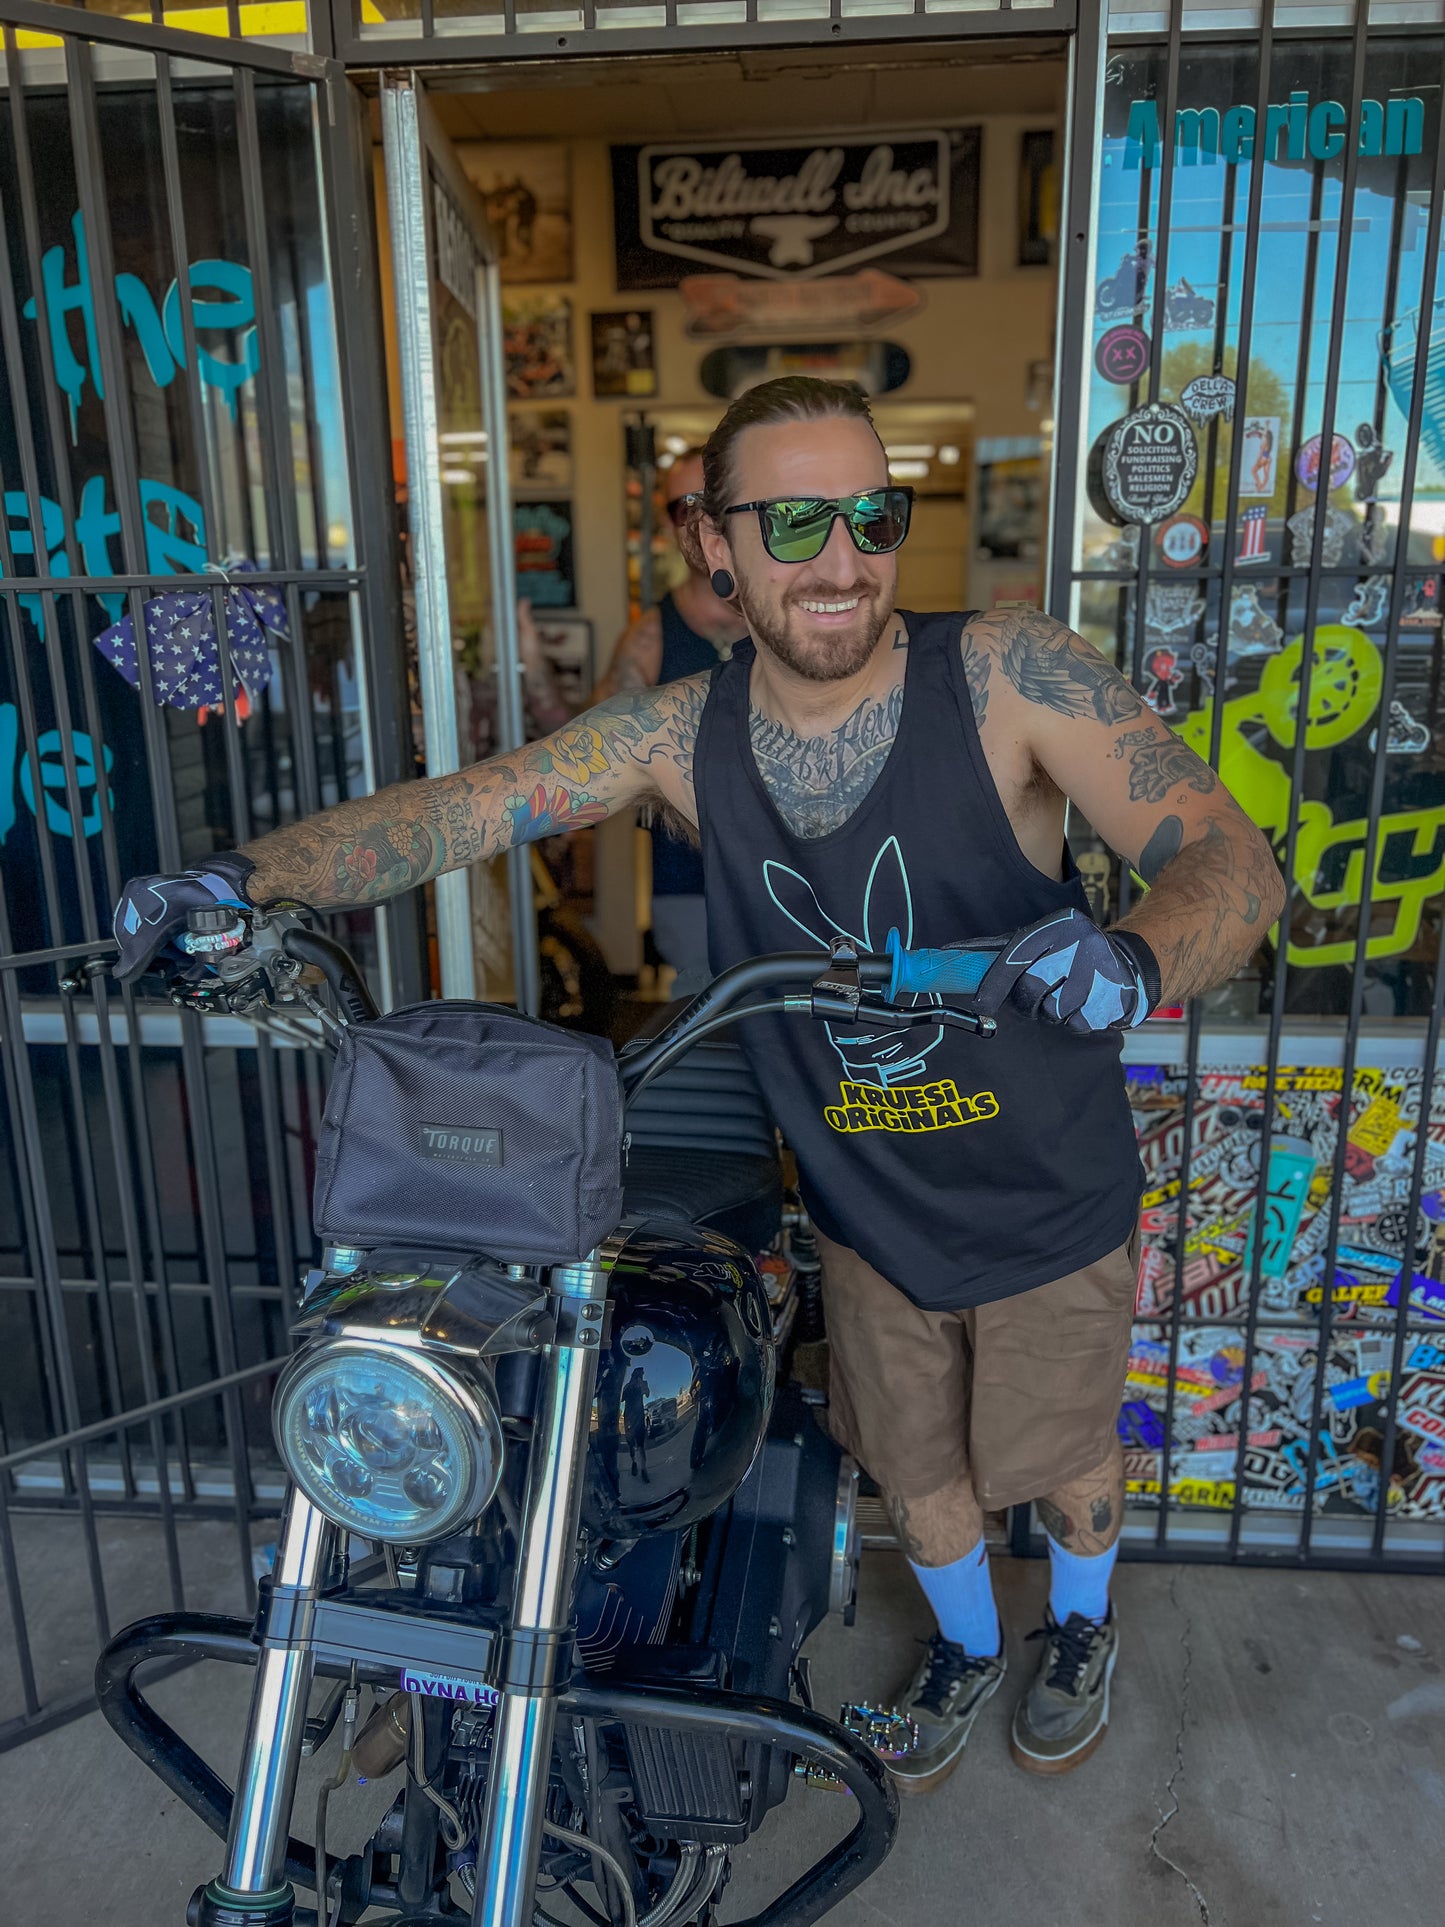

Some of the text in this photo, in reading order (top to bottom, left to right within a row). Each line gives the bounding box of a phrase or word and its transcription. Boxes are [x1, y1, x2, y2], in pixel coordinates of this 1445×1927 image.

[1124, 91, 1425, 170] American
[1191, 394, 1228, 411] CREW
[1132, 423, 1175, 445] NO
[1127, 445, 1178, 455] SOLICITING
[1121, 455, 1183, 464] FUNDRAISING
[1131, 464, 1171, 473] POLITICS
[1127, 474, 1174, 483] SALESMEN
[1128, 483, 1171, 492] RELIGION
[423, 1127, 497, 1154] TORQUE
[406, 1677, 469, 1702] DYNA
